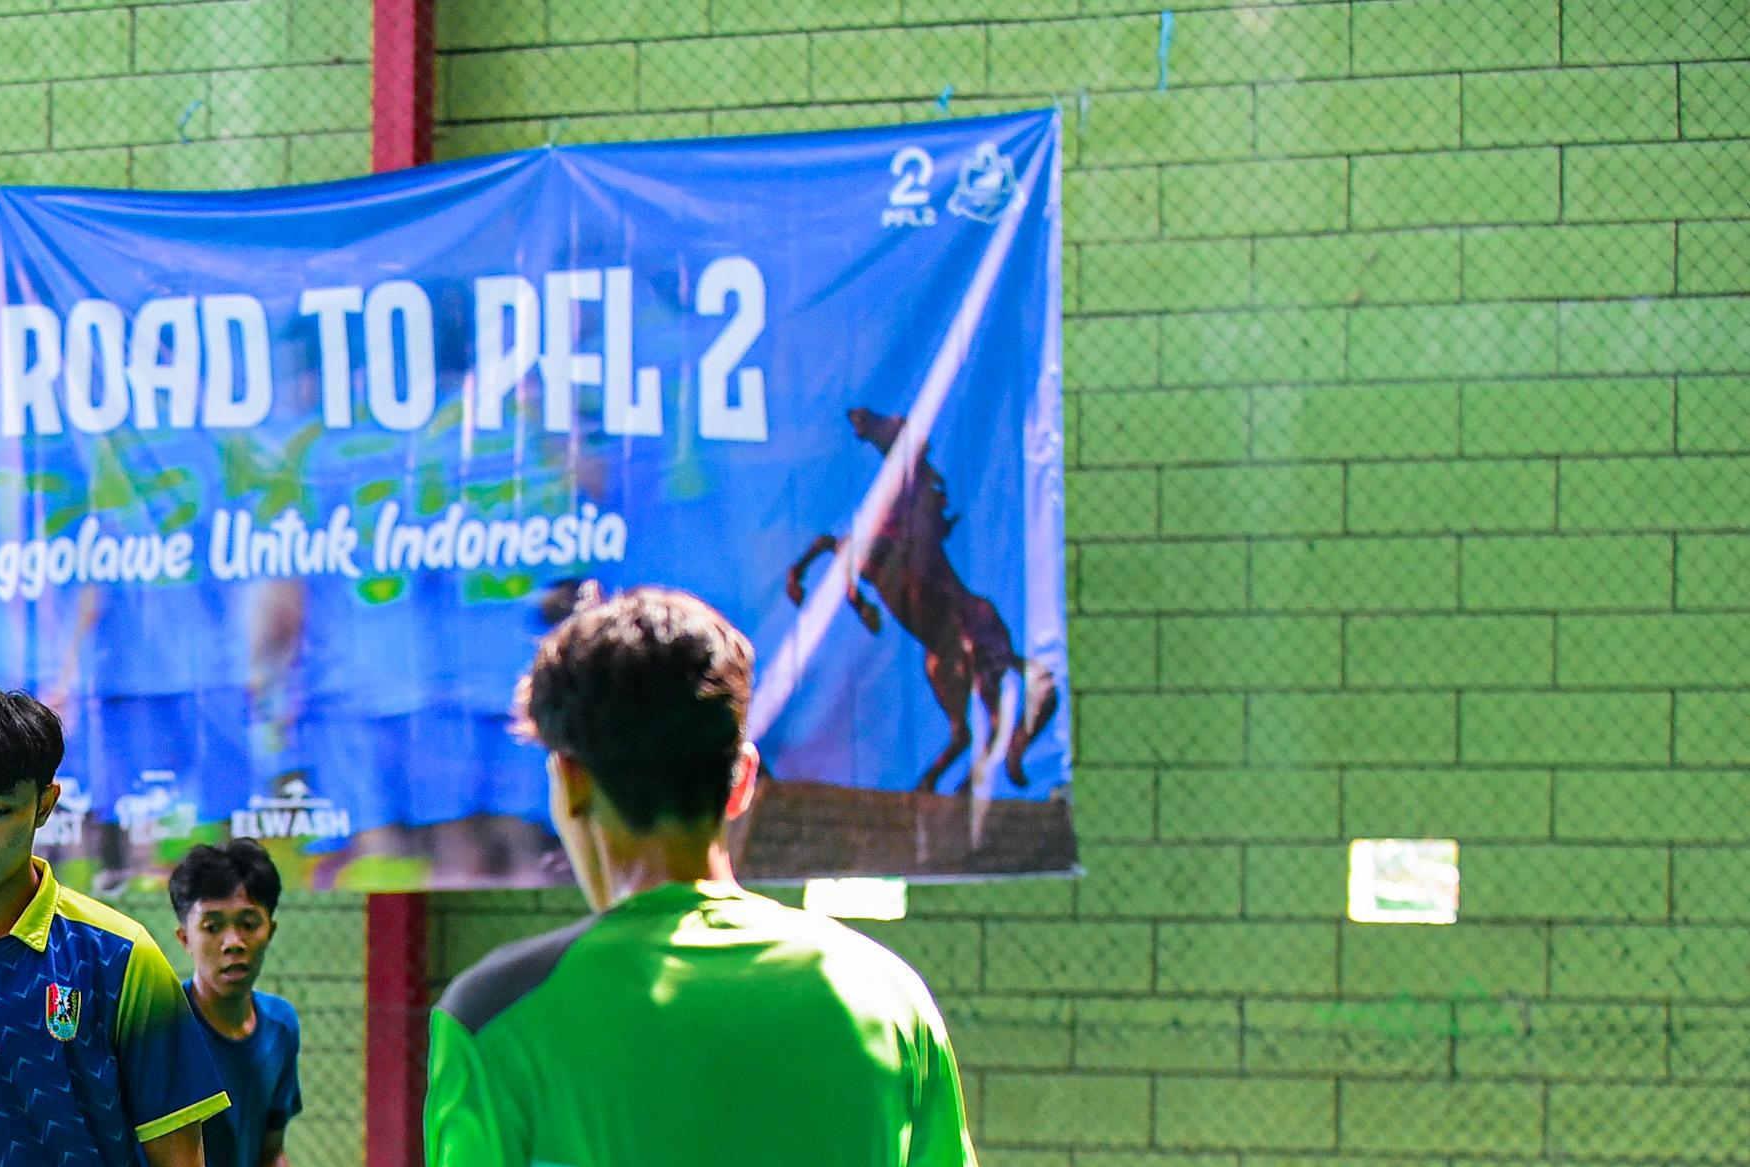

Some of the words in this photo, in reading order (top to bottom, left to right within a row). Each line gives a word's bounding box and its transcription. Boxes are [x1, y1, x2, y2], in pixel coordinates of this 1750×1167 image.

[0, 297, 272, 437] ROAD
[301, 280, 435, 432] TO
[474, 266, 663, 437] PFL
[697, 256, 769, 442] 2
[209, 504, 363, 580] Untuk
[371, 503, 627, 570] Indonesia
[230, 809, 350, 839] ELWASH
